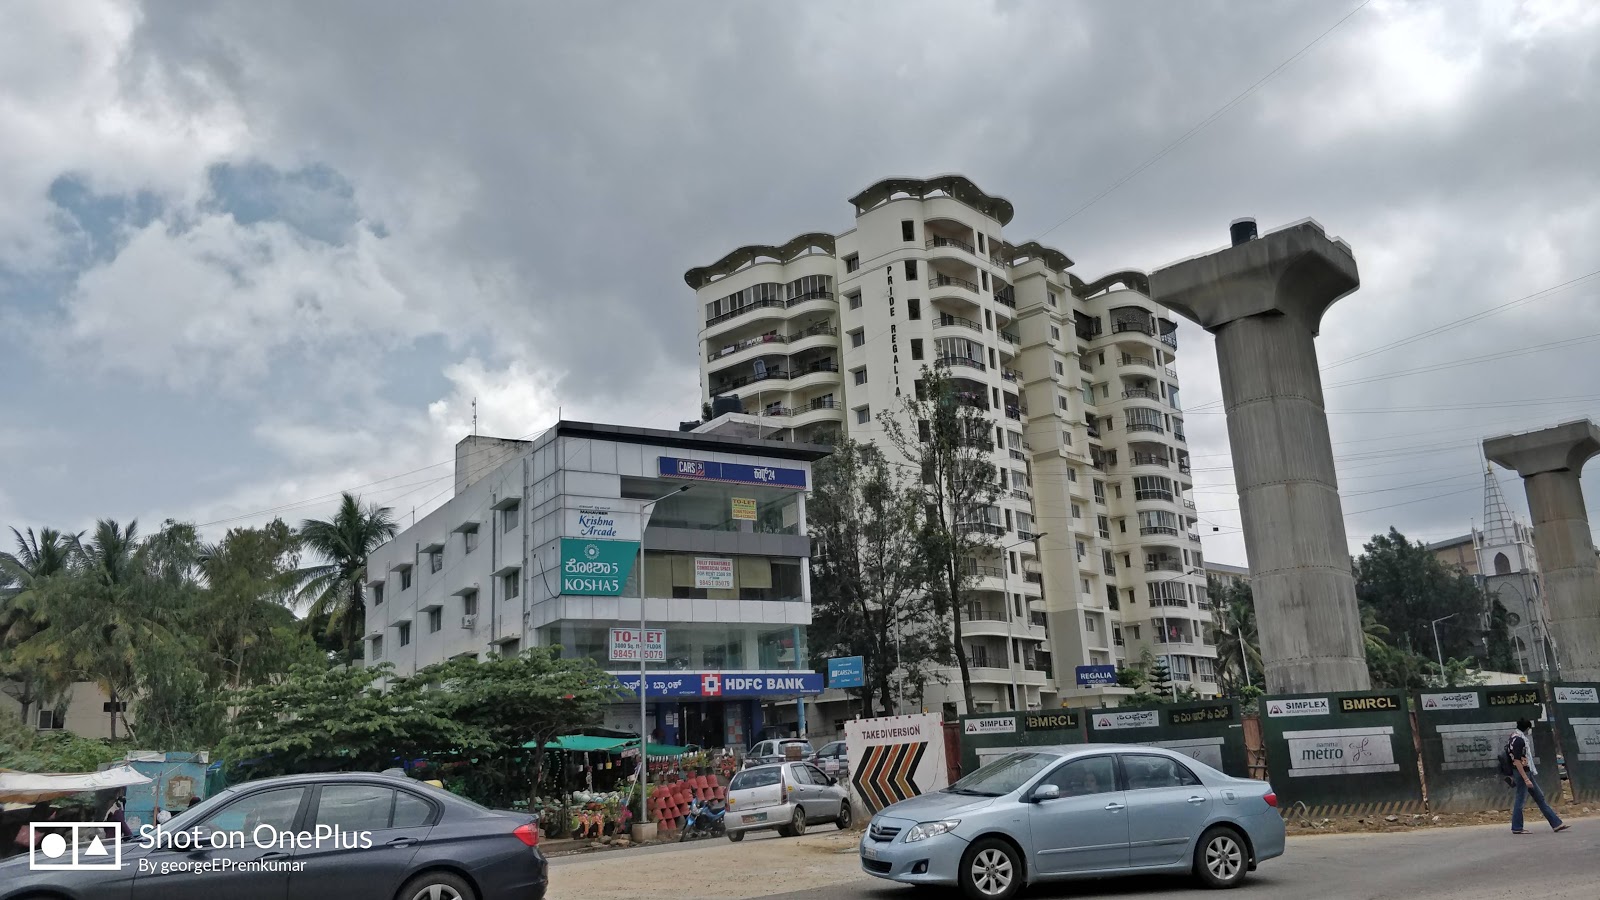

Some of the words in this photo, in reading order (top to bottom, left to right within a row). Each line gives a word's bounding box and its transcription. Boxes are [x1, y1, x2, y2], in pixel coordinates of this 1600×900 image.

[891, 324, 900, 397] REGALIA
[679, 461, 696, 474] CARS
[579, 515, 614, 527] Krishna
[581, 526, 616, 536] Arcade
[725, 678, 762, 690] HDFC
[767, 678, 804, 690] BANK
[1286, 701, 1327, 710] SIMPLEX
[1343, 697, 1396, 710] BMRCL
[1029, 715, 1075, 728] BMRCL
[862, 730, 880, 740] TAKE
[881, 726, 920, 738] DIVERSION
[1303, 748, 1343, 760] metro
